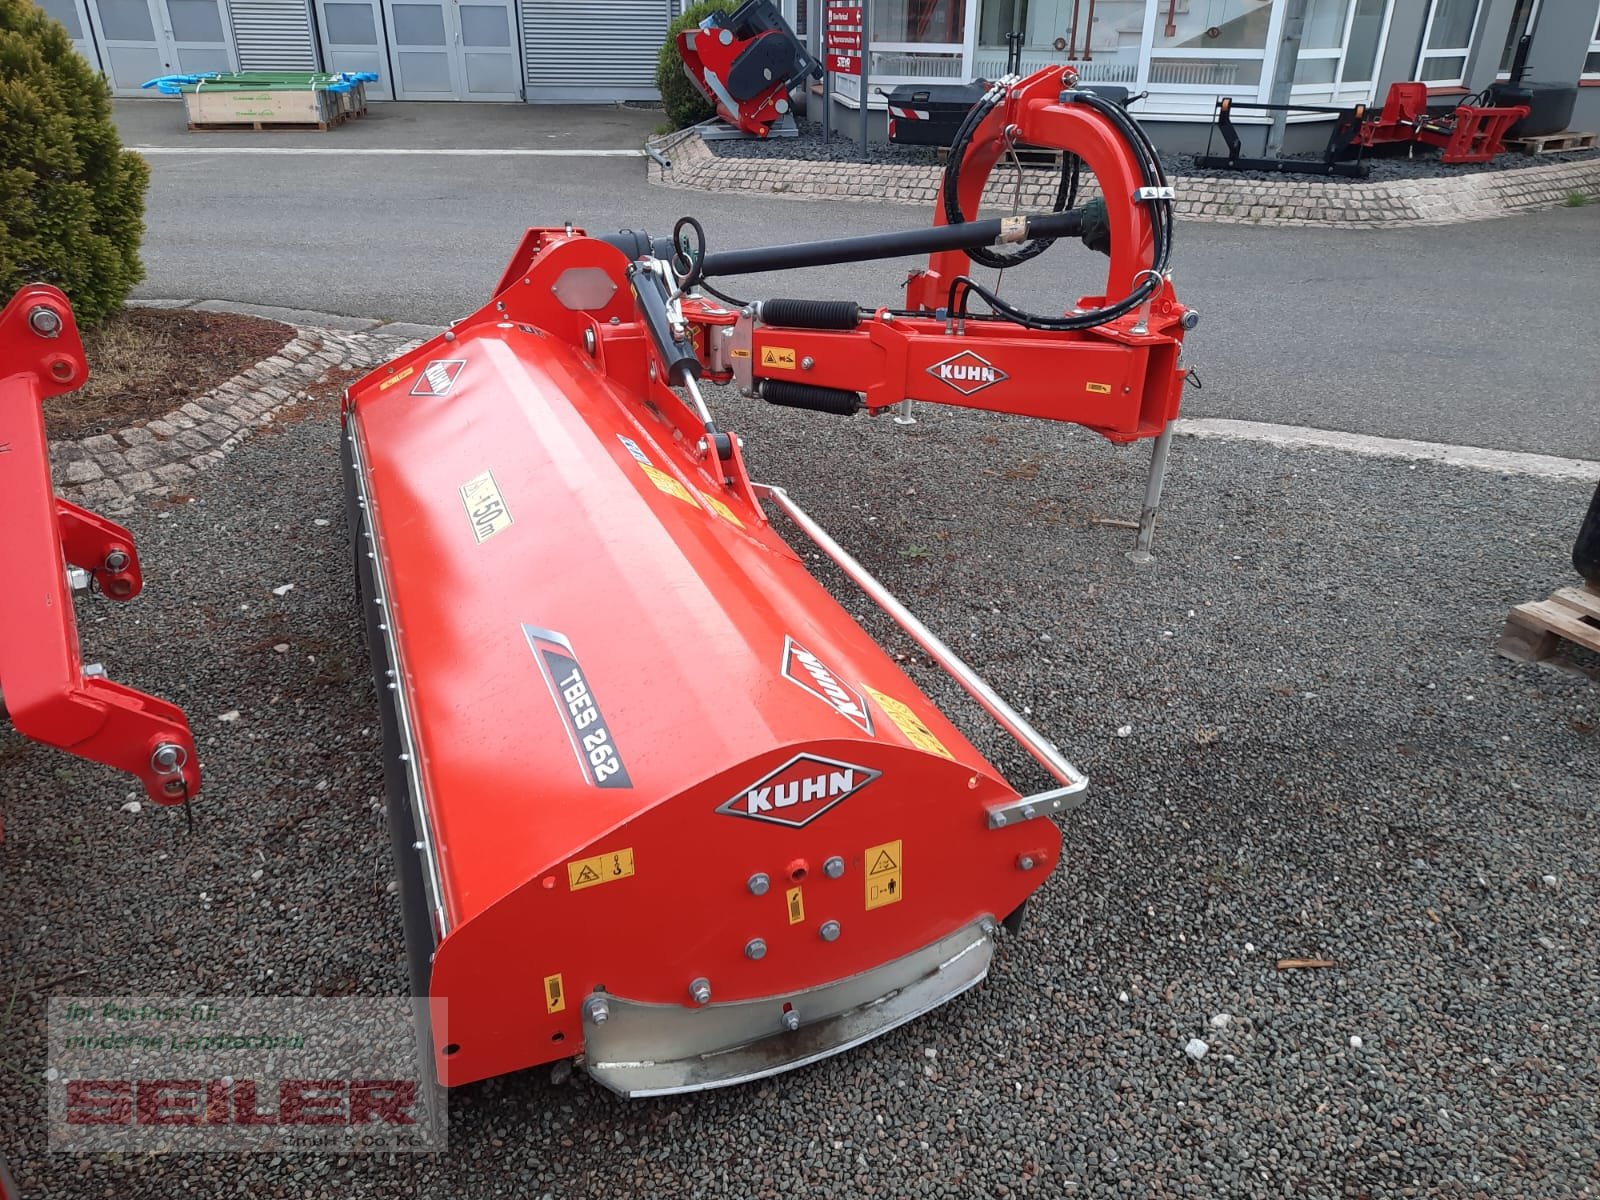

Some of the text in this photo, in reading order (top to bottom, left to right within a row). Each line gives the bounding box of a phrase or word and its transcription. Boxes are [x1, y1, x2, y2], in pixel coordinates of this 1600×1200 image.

[425, 362, 451, 394] KUHN
[940, 364, 996, 382] KUHN
[789, 647, 866, 719] KUHN
[559, 668, 620, 782] TBES 262
[747, 768, 854, 815] KUHN
